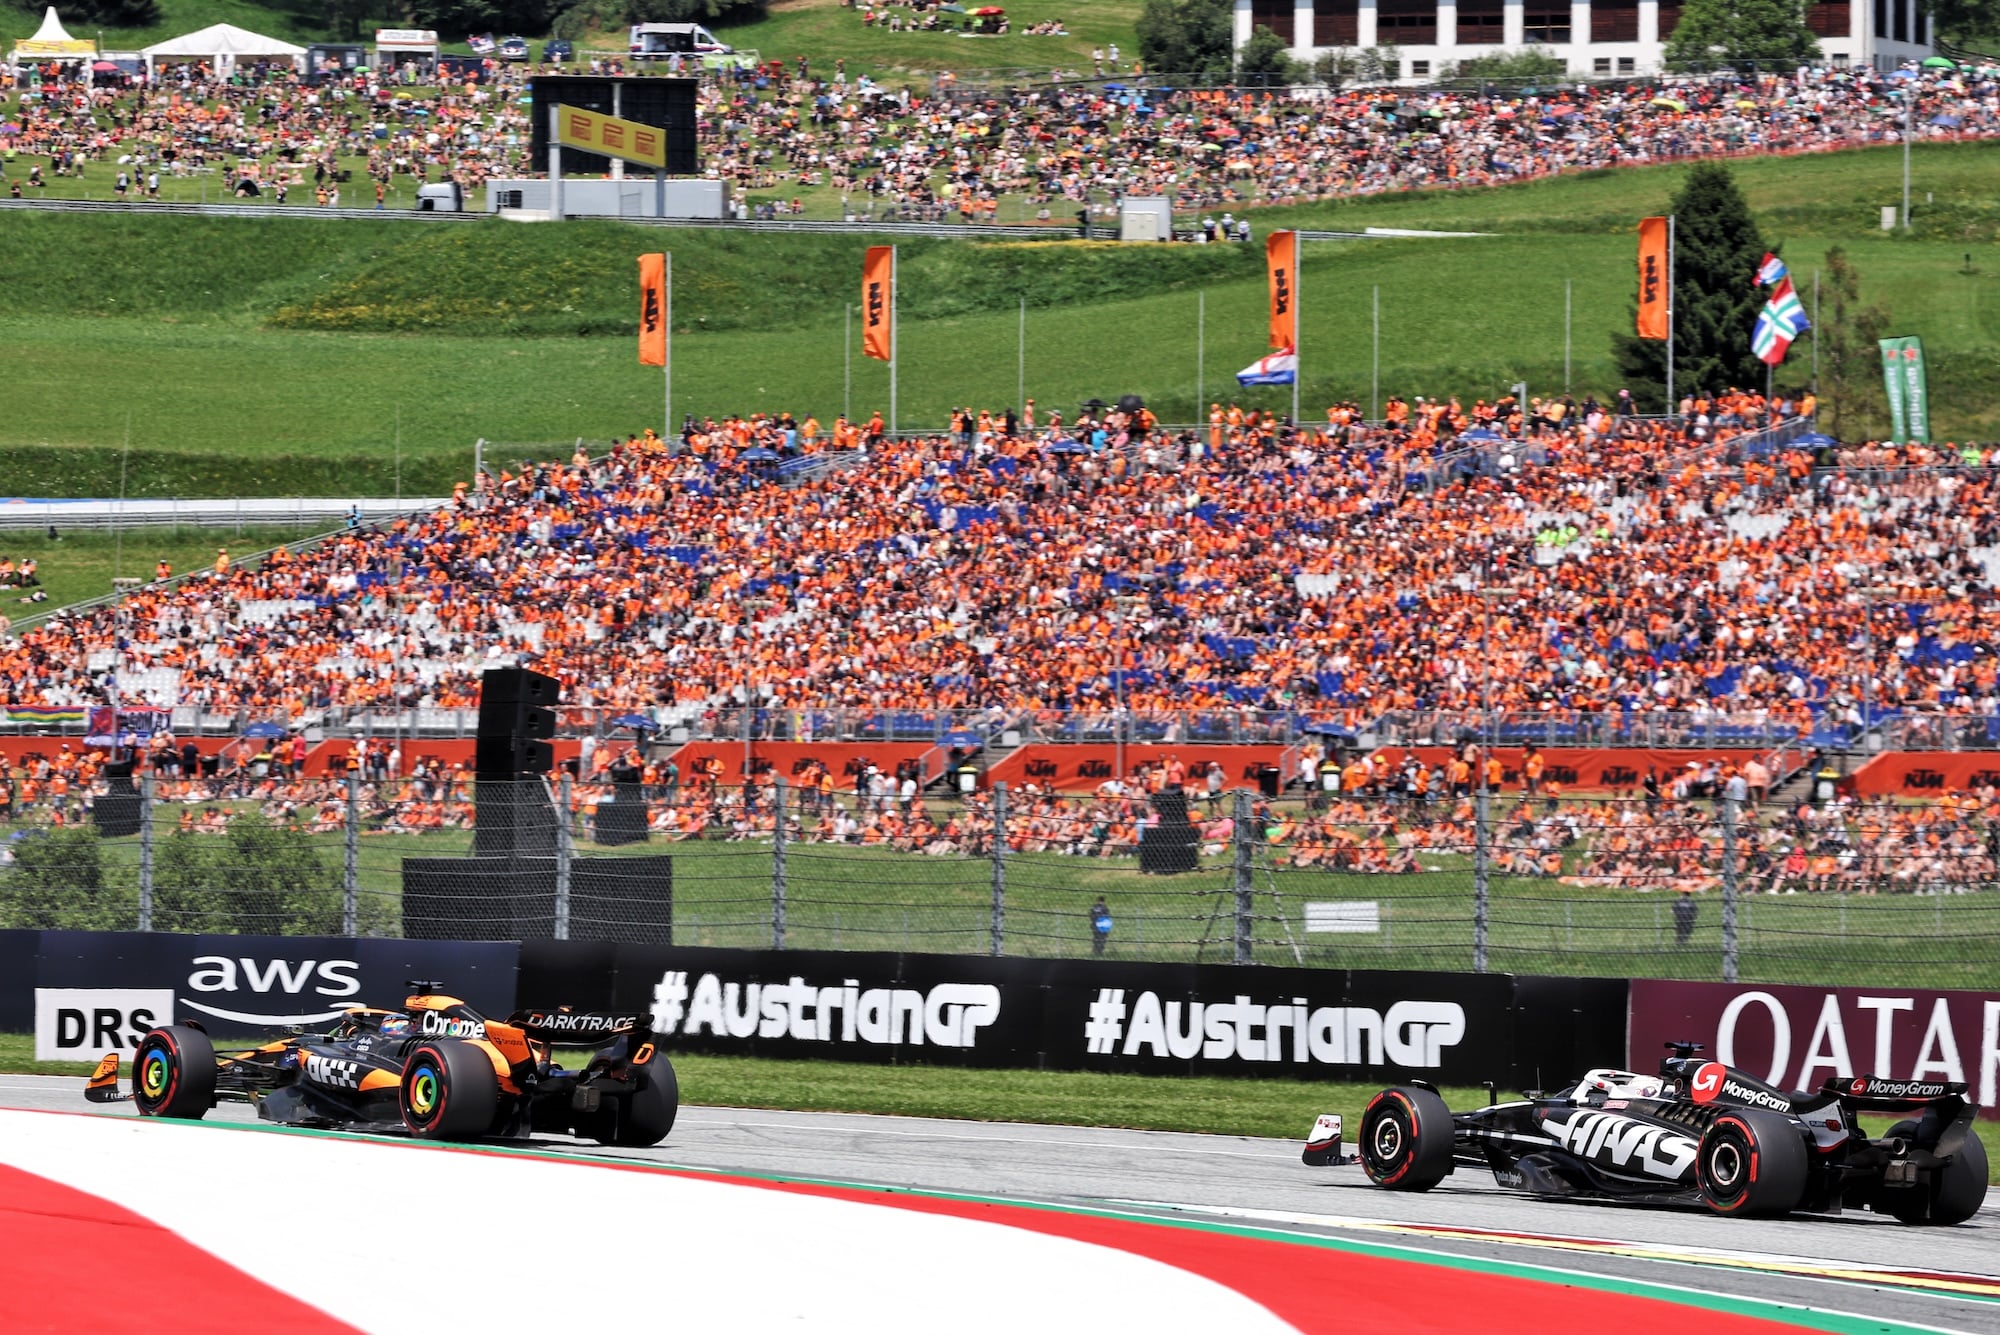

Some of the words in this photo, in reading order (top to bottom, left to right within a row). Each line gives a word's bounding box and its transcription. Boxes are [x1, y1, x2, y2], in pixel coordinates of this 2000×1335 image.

[869, 282, 882, 327] KTM
[1024, 759, 1058, 777] KTM
[1077, 760, 1112, 778] KTM
[1601, 766, 1638, 785] KTM
[1903, 769, 1945, 788] KTM
[187, 955, 361, 997] aws
[422, 1010, 486, 1038] Chrome
[527, 1013, 636, 1031] DARKTRACE
[650, 970, 1001, 1047] #AustrianGP
[55, 1007, 156, 1049] DRS
[1085, 988, 1466, 1068] #AustrianGP
[307, 1055, 358, 1089] OKX
[1866, 1080, 1944, 1096] MoneyGram
[1721, 1079, 1791, 1113] MoneyGram
[1541, 1110, 1700, 1180] HAAS
